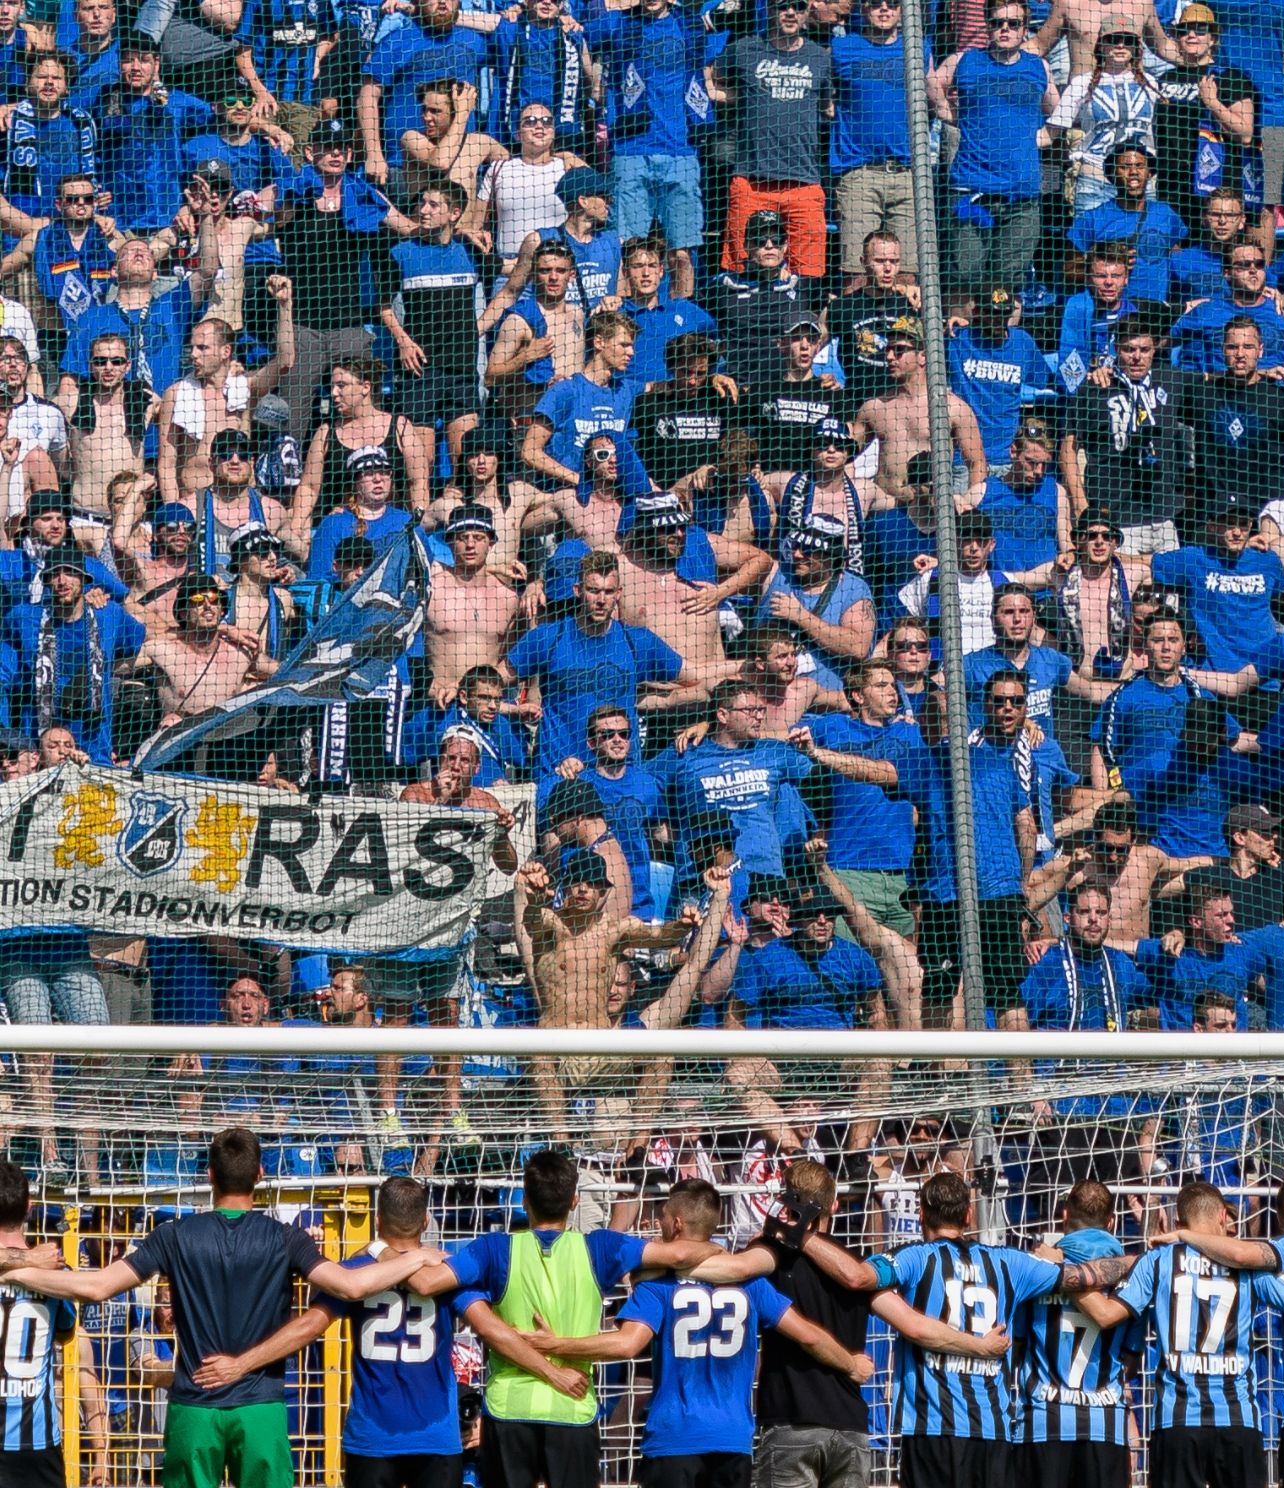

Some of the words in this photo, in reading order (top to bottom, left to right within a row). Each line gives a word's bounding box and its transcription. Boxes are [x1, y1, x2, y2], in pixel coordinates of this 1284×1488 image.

[700, 768, 770, 790] WALDHOF
[67, 883, 361, 936] STADIONVERBOT
[360, 1290, 437, 1363] 23
[673, 1286, 748, 1359] 23
[946, 1279, 997, 1338] 13
[1173, 1275, 1238, 1353] 17
[0, 1302, 51, 1379] 0
[946, 1354, 1003, 1378] WALDHOF
[1060, 1311, 1100, 1389] 7
[1181, 1355, 1245, 1375] WALDHOF
[1039, 1384, 1058, 1402] SV
[1060, 1388, 1120, 1407] WALDHOF
